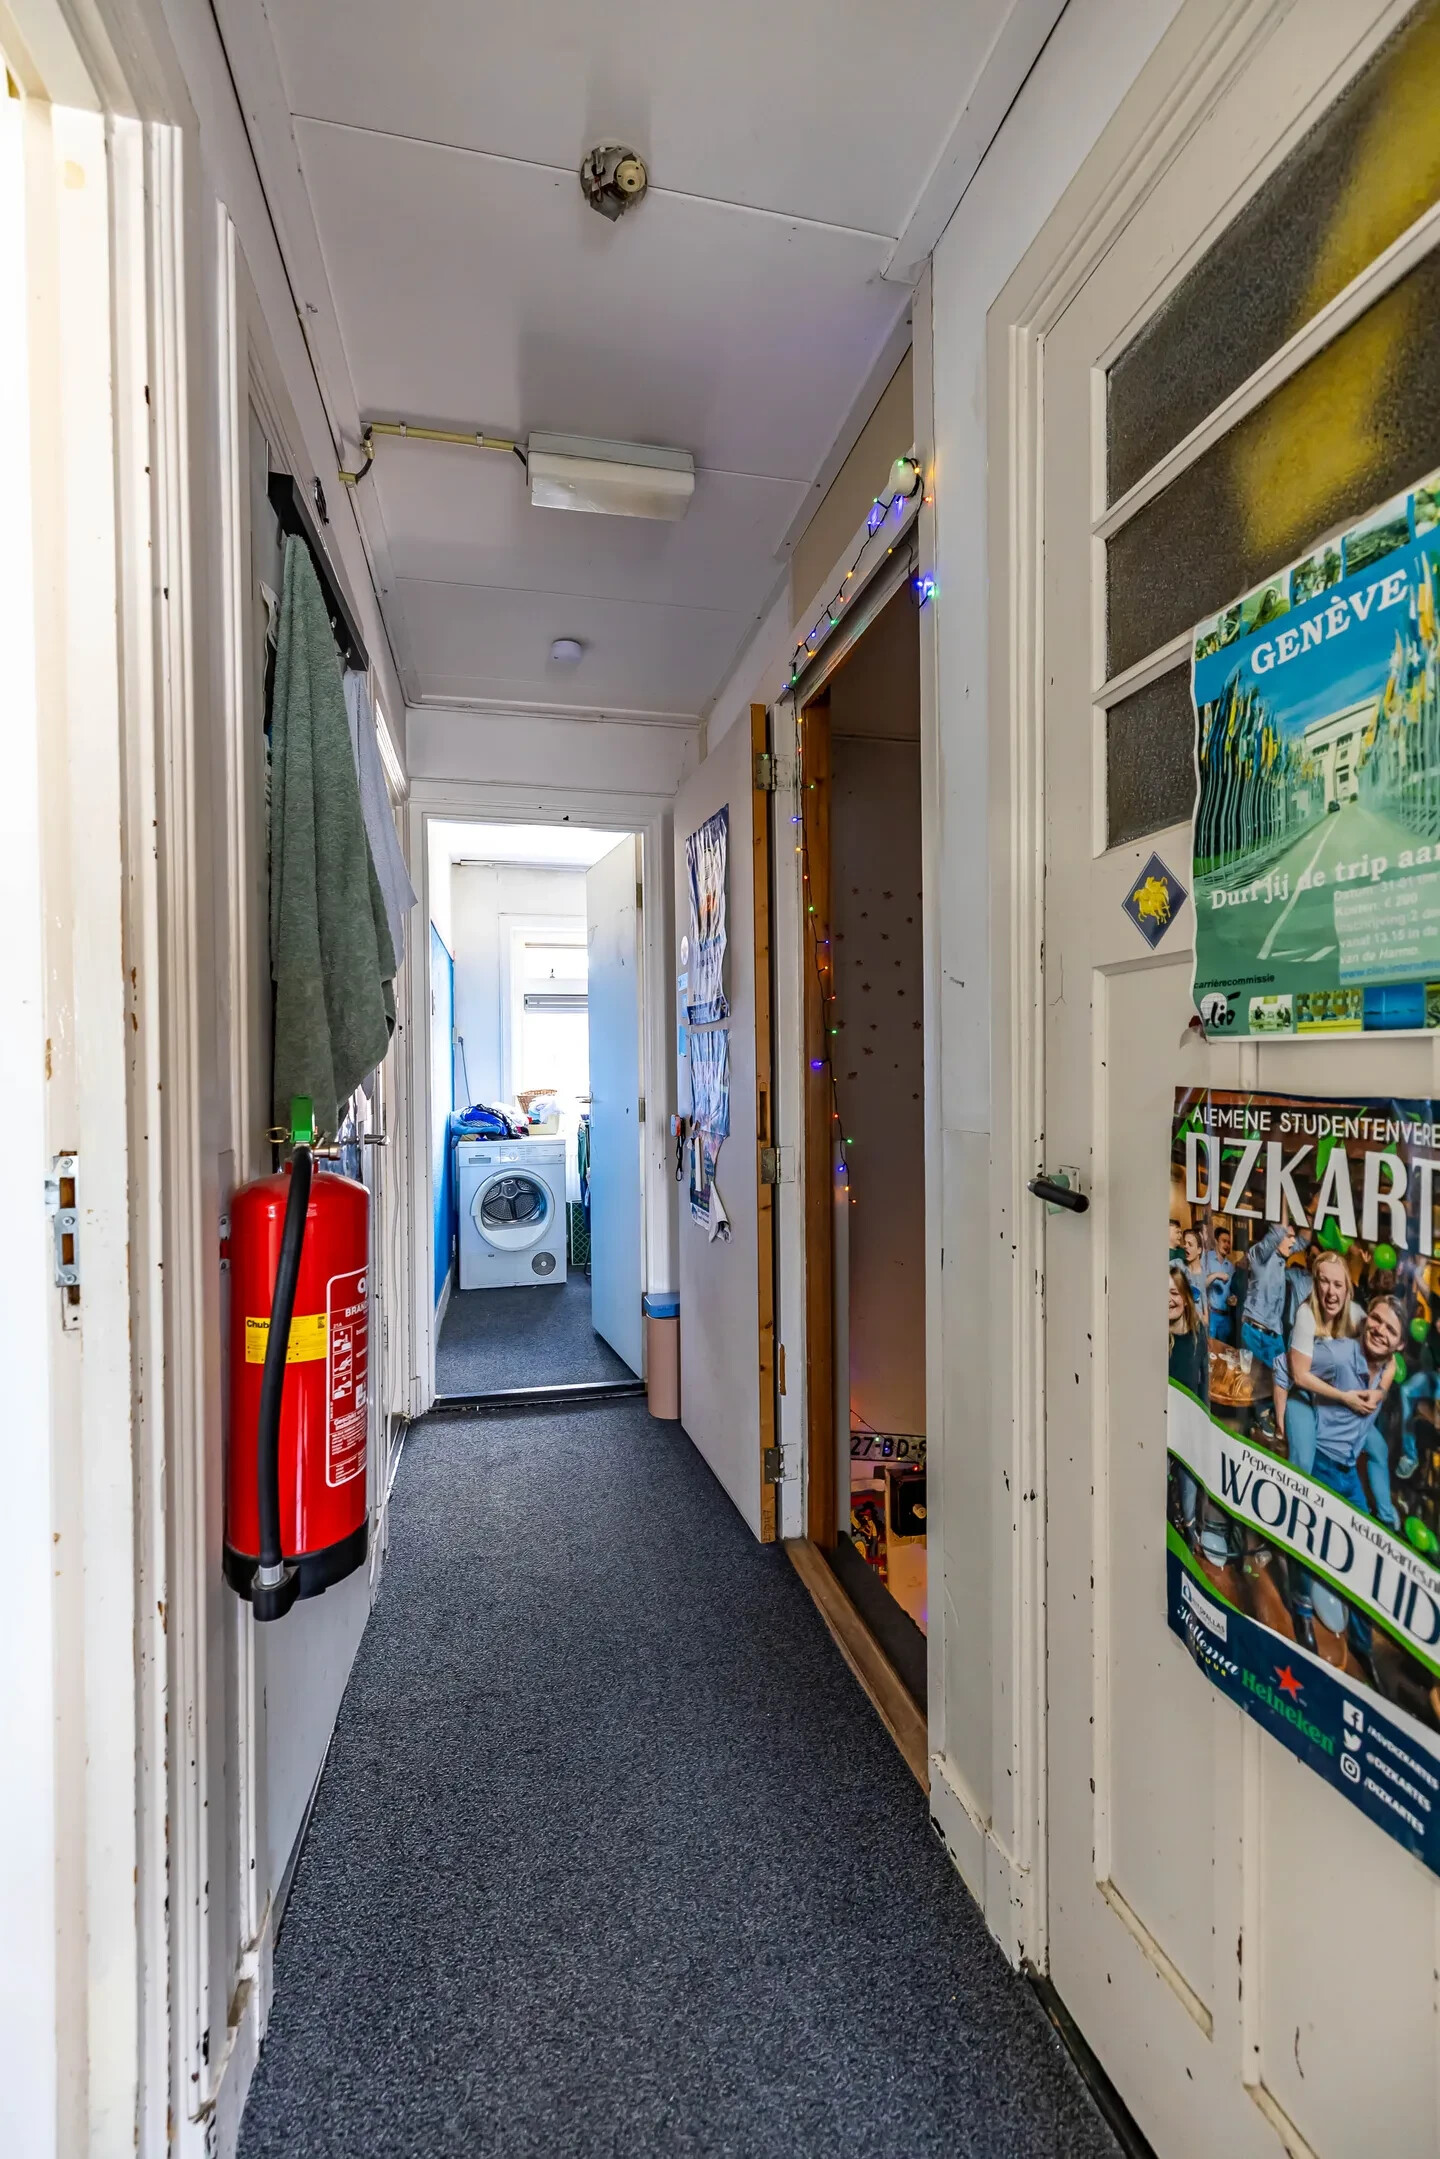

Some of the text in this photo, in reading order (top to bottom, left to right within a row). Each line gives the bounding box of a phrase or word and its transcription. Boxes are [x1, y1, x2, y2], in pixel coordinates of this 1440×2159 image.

[1251, 568, 1409, 674] GENÈVE
[1335, 854, 1387, 881] trip
[246, 1319, 270, 1329] Chub
[1220, 1451, 1354, 1573] WORD
[1241, 1668, 1335, 1756] Heineken
